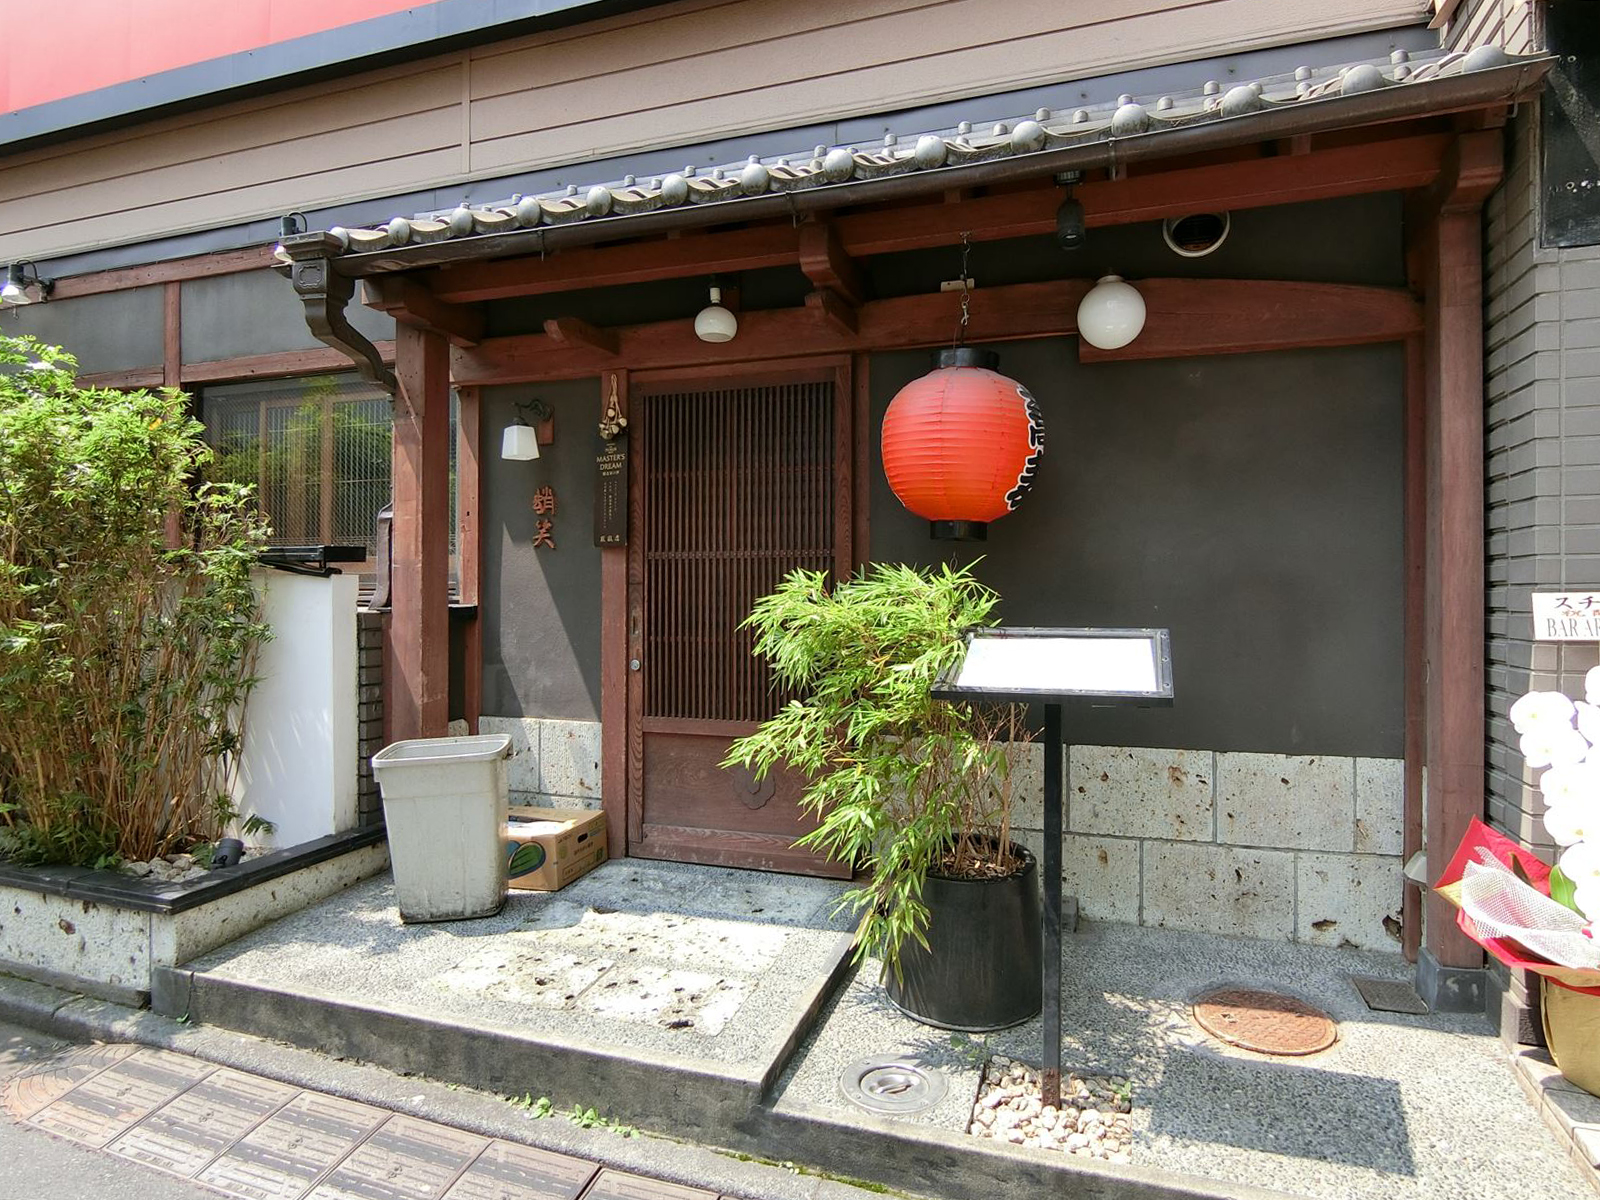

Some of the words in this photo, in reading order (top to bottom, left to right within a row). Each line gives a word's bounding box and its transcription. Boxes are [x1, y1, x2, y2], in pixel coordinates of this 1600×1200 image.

[596, 453, 626, 463] MASTER'S
[599, 462, 622, 471] DREAM
[1546, 617, 1579, 638] BAR
